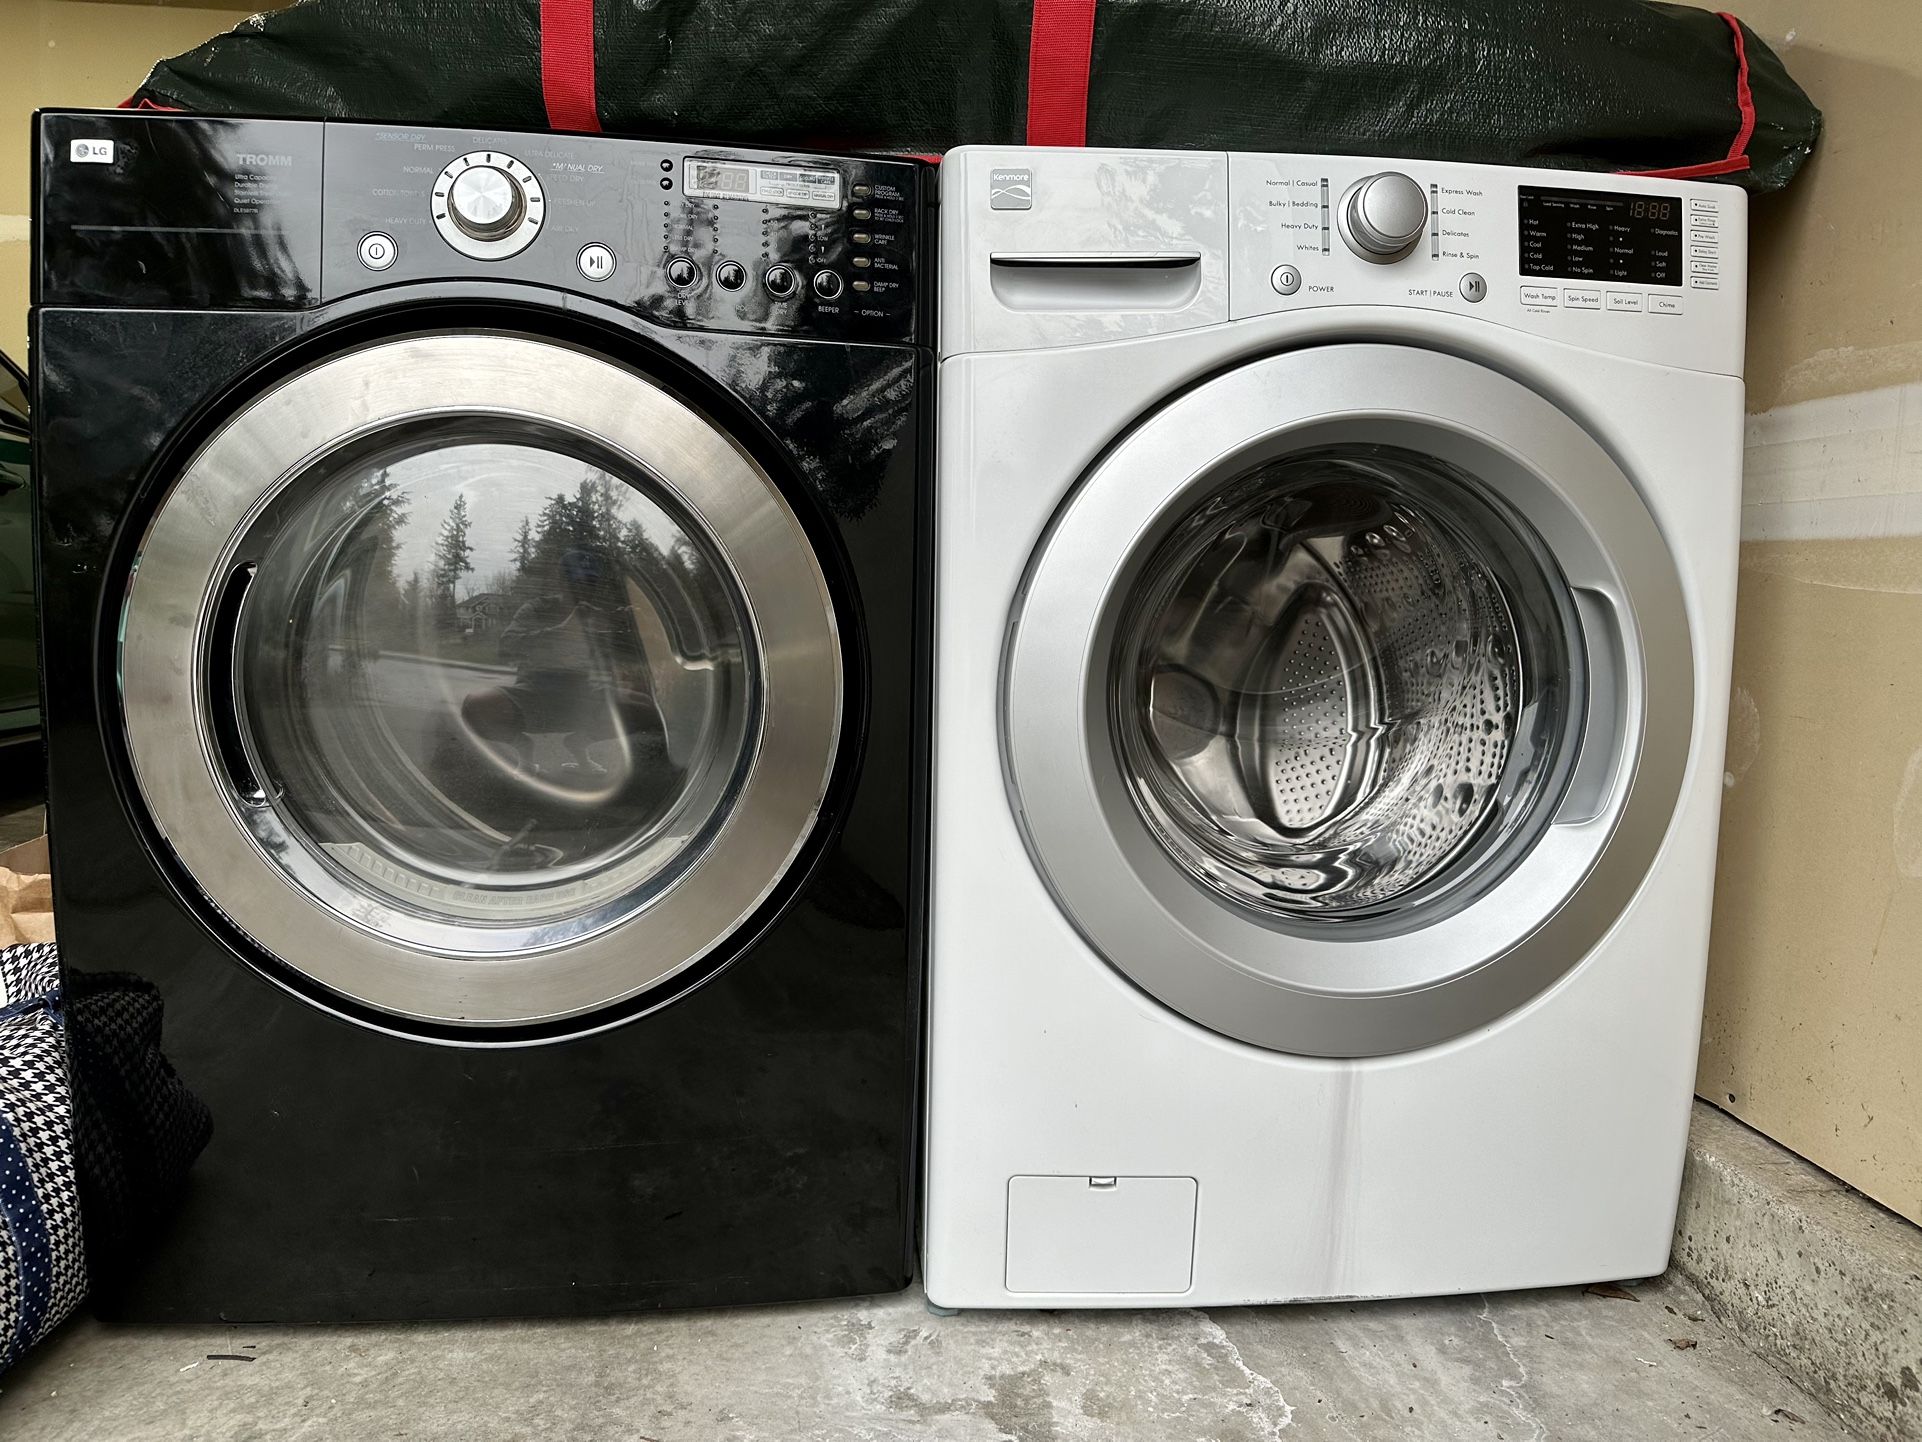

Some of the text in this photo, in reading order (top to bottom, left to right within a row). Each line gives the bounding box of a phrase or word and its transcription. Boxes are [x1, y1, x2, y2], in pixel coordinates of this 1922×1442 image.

[92, 146, 107, 156] LG
[414, 143, 457, 152] PERM PRESS
[236, 153, 293, 166] TROMM
[993, 173, 1030, 181] Kenmore
[1441, 187, 1483, 197] Express Wash
[1268, 200, 1319, 209] Bulky Bedding
[1441, 207, 1476, 216] Cold Clean
[1281, 222, 1319, 231] Heavy Duty
[1571, 221, 1600, 231] Extra High
[1613, 225, 1631, 233] Heavy
[1442, 229, 1470, 238] Delicates
[1571, 233, 1585, 241] High
[1296, 244, 1320, 252] Whites
[1529, 240, 1542, 248] Cool
[1572, 244, 1594, 252] Medium
[1442, 250, 1480, 260] Rinse & Spin
[1530, 263, 1541, 271] Tap
[1582, 266, 1594, 274] Spin
[1614, 269, 1628, 277] Light
[1656, 271, 1666, 279] Off
[1308, 285, 1335, 293] POWER
[1432, 290, 1454, 298] PAUSE
[1524, 292, 1557, 301] Wash Temp
[1581, 295, 1599, 303] Speed
[818, 305, 840, 314] BEEPER
[861, 309, 884, 317] OPTION
